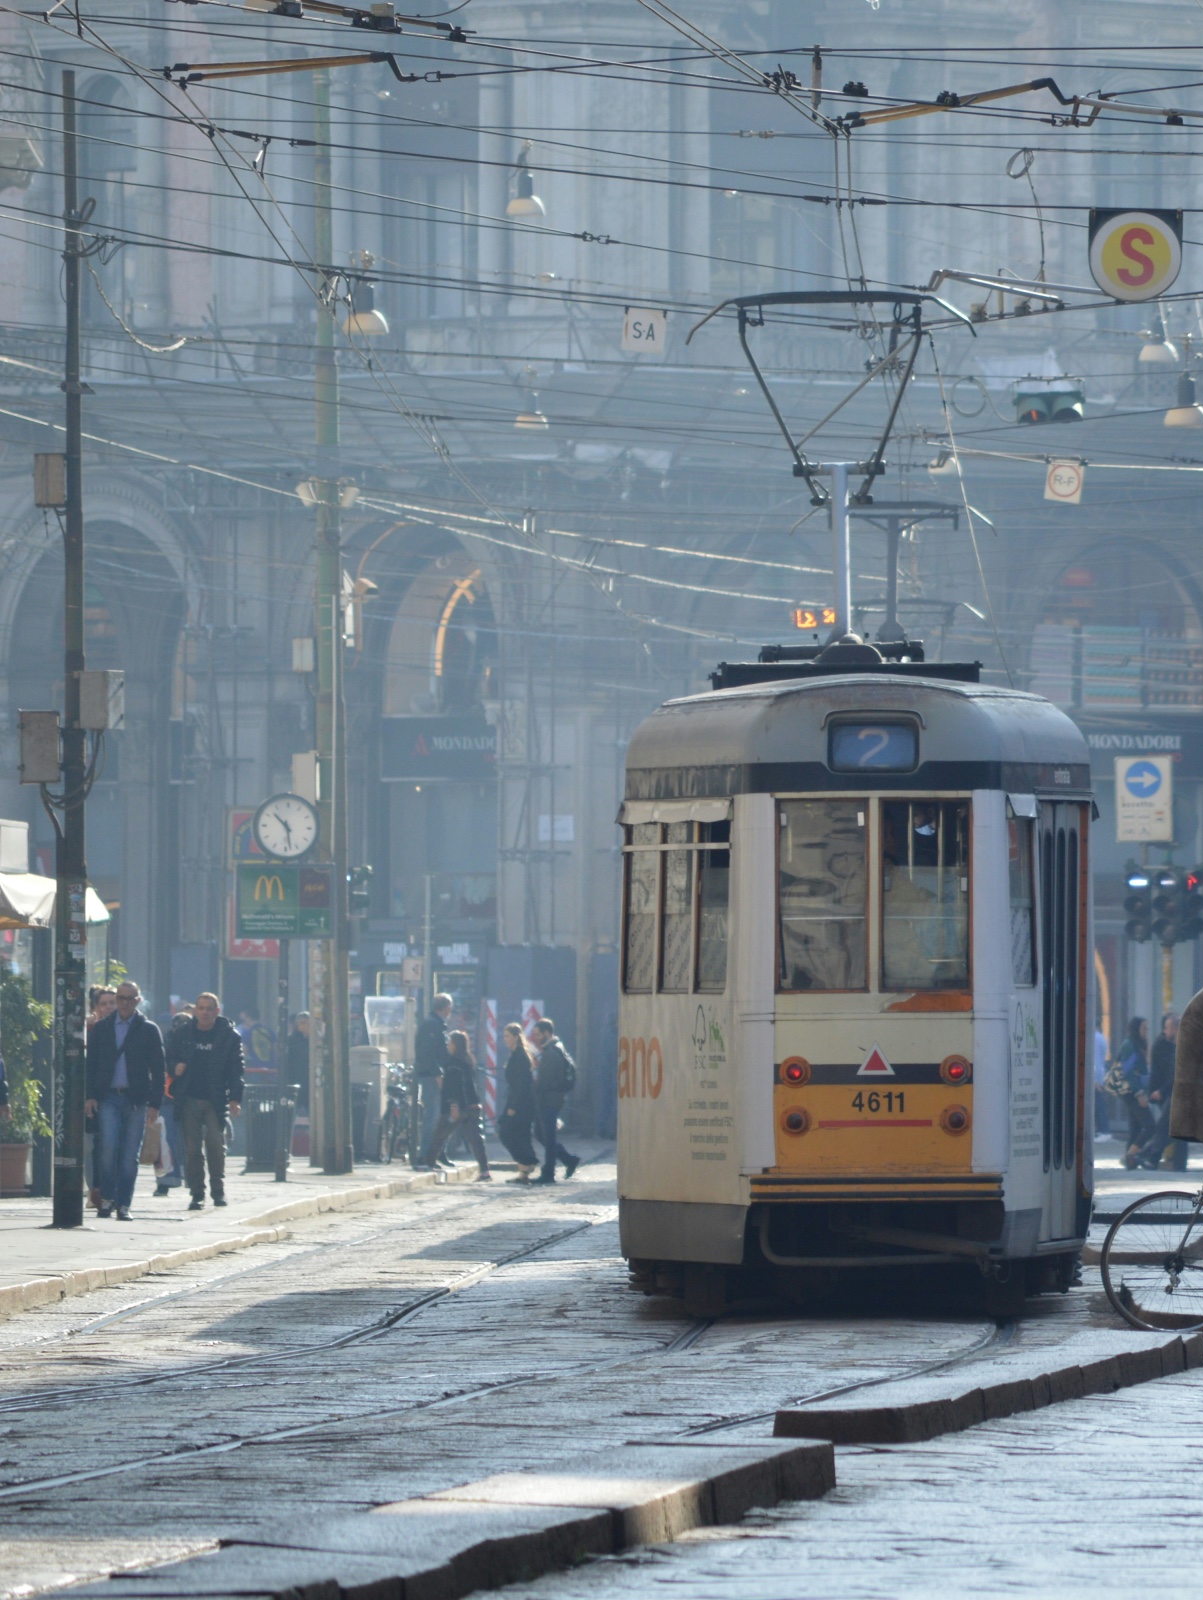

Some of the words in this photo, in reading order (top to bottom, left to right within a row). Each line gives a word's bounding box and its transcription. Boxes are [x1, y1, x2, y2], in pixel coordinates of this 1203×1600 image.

[1117, 227, 1155, 287] S
[858, 727, 889, 768] 2
[1088, 734, 1182, 749] MONDADORI
[852, 1091, 905, 1113] 4611
